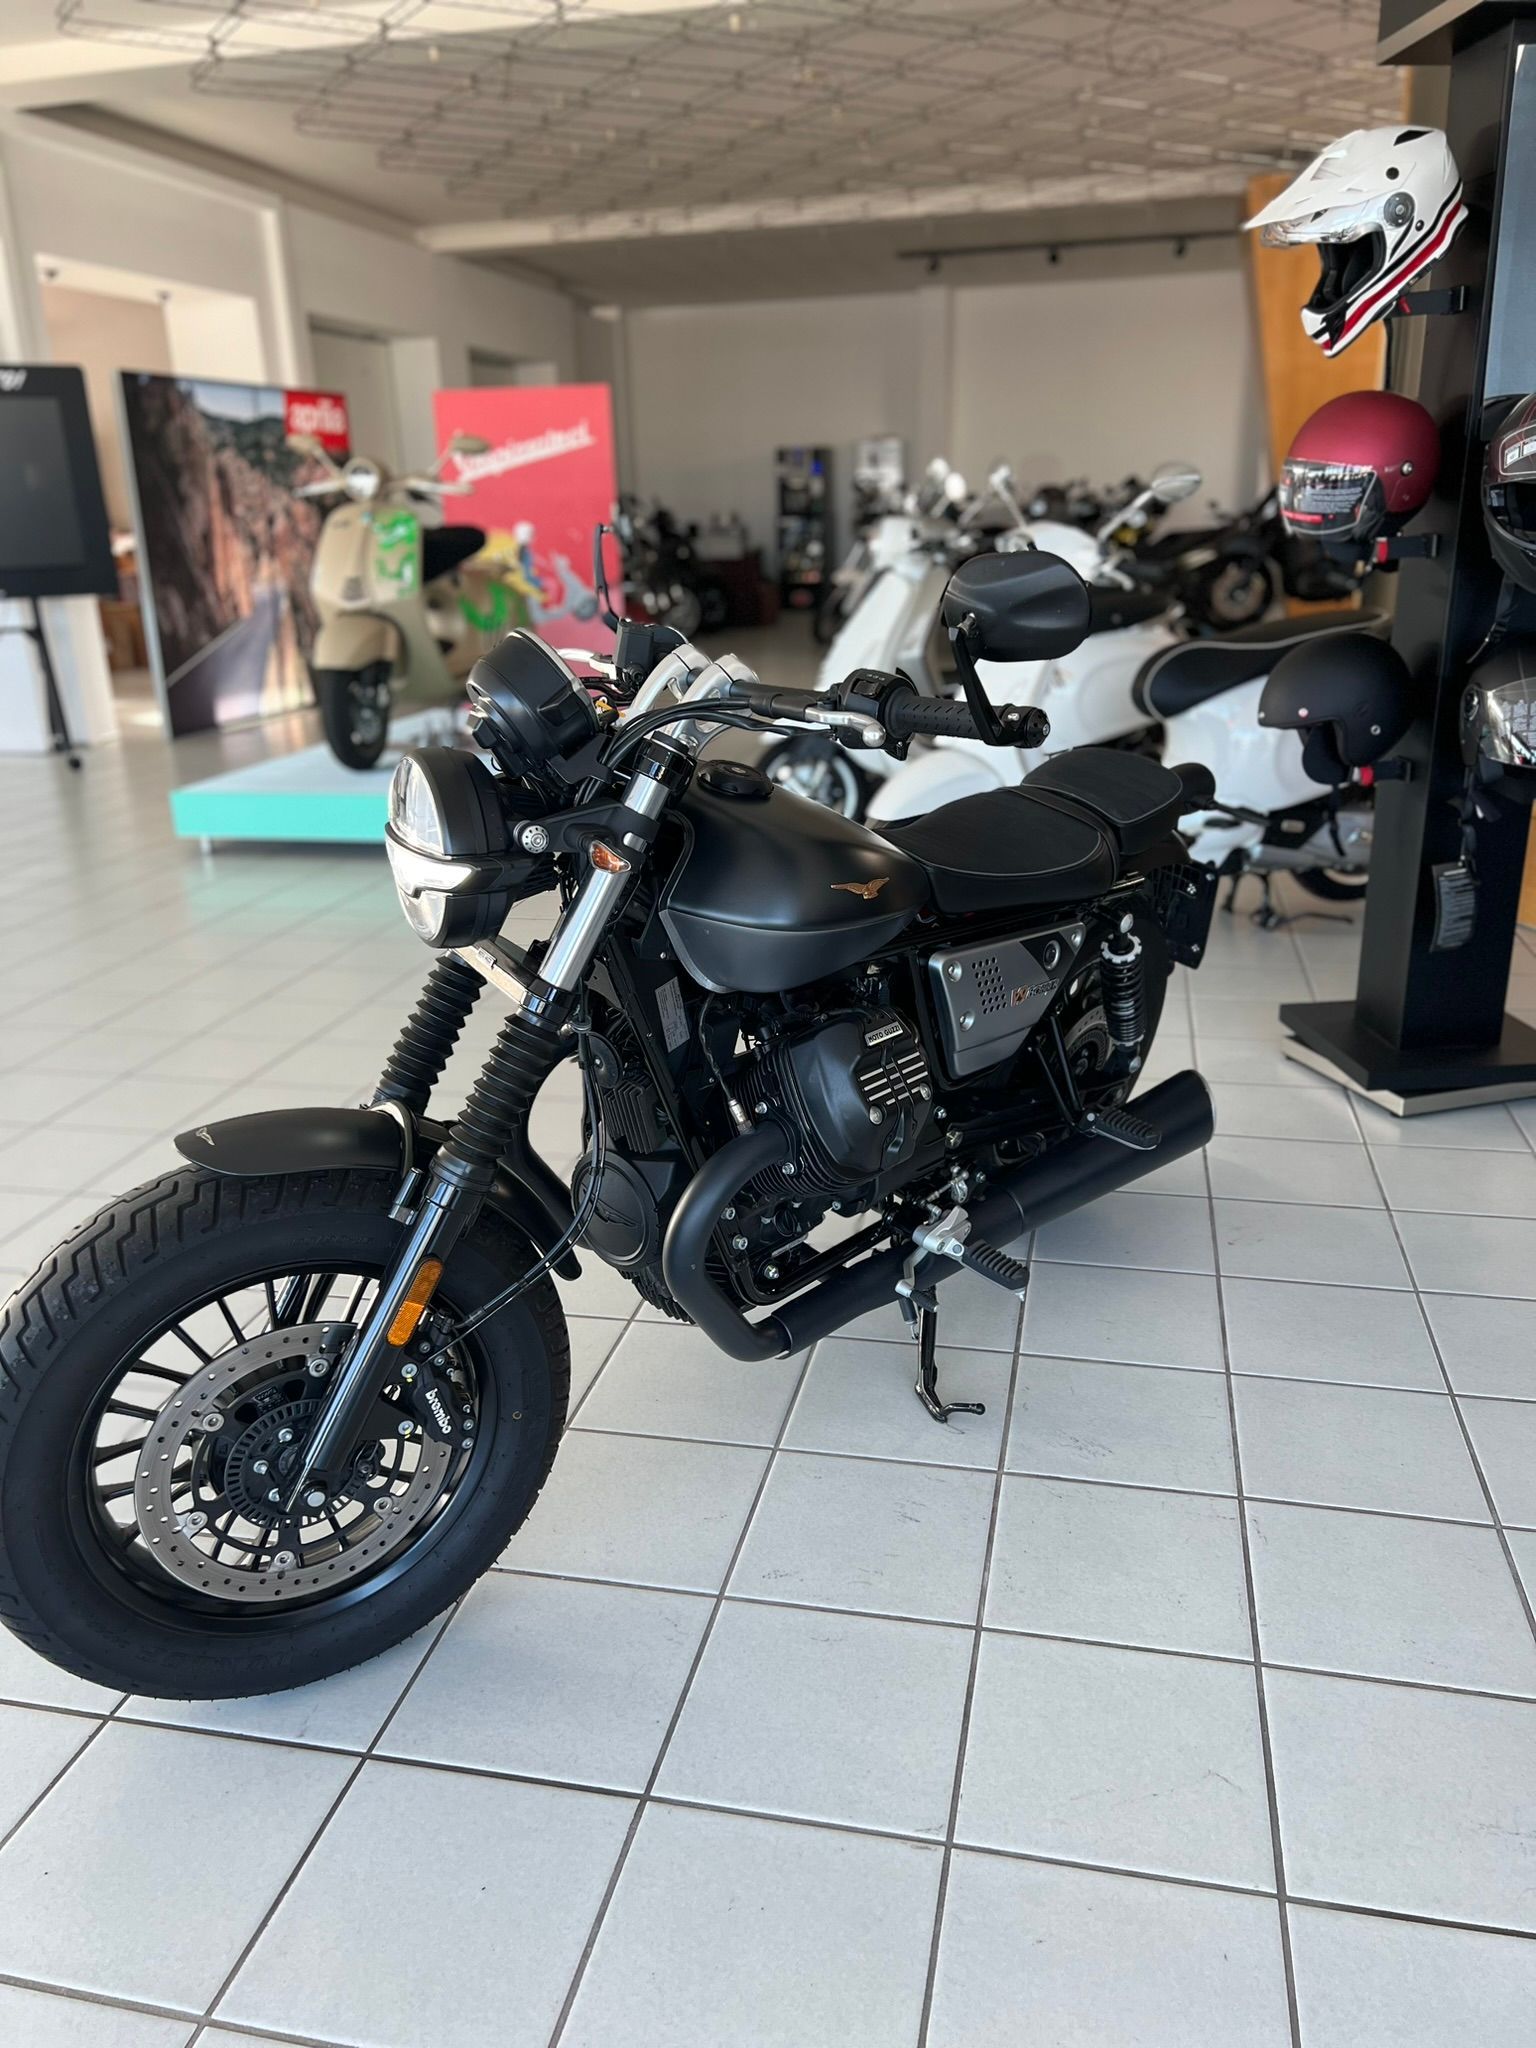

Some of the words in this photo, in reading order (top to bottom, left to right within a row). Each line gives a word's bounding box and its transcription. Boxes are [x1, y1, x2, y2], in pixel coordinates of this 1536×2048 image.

[868, 1032, 883, 1042] MOTO
[884, 1025, 900, 1036] GUZZI
[425, 1388, 452, 1434] brembo
